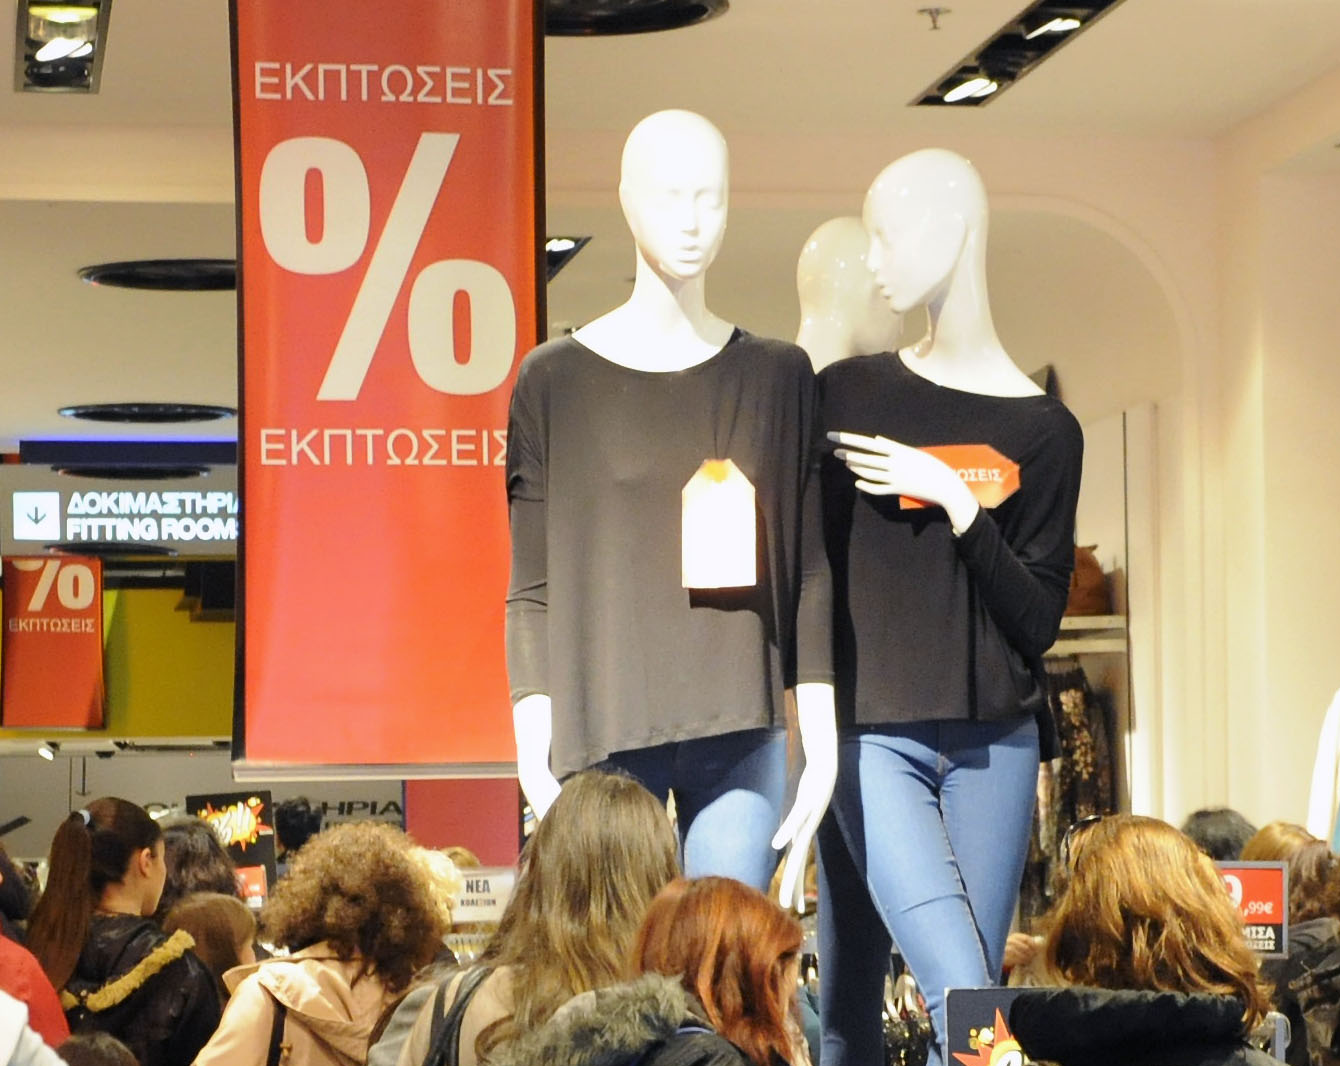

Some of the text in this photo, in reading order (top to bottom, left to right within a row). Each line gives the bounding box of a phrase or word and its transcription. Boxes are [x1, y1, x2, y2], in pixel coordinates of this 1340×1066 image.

[254, 61, 513, 105] ΕΚΠΤΩΣΕΙΣ
[260, 428, 507, 467] ΕΚΠΤΩΣΕΙΣ
[66, 517, 239, 541] FITTING ROOM
[9, 617, 95, 633] ΕΚΠΤΩΣΕΙΣ
